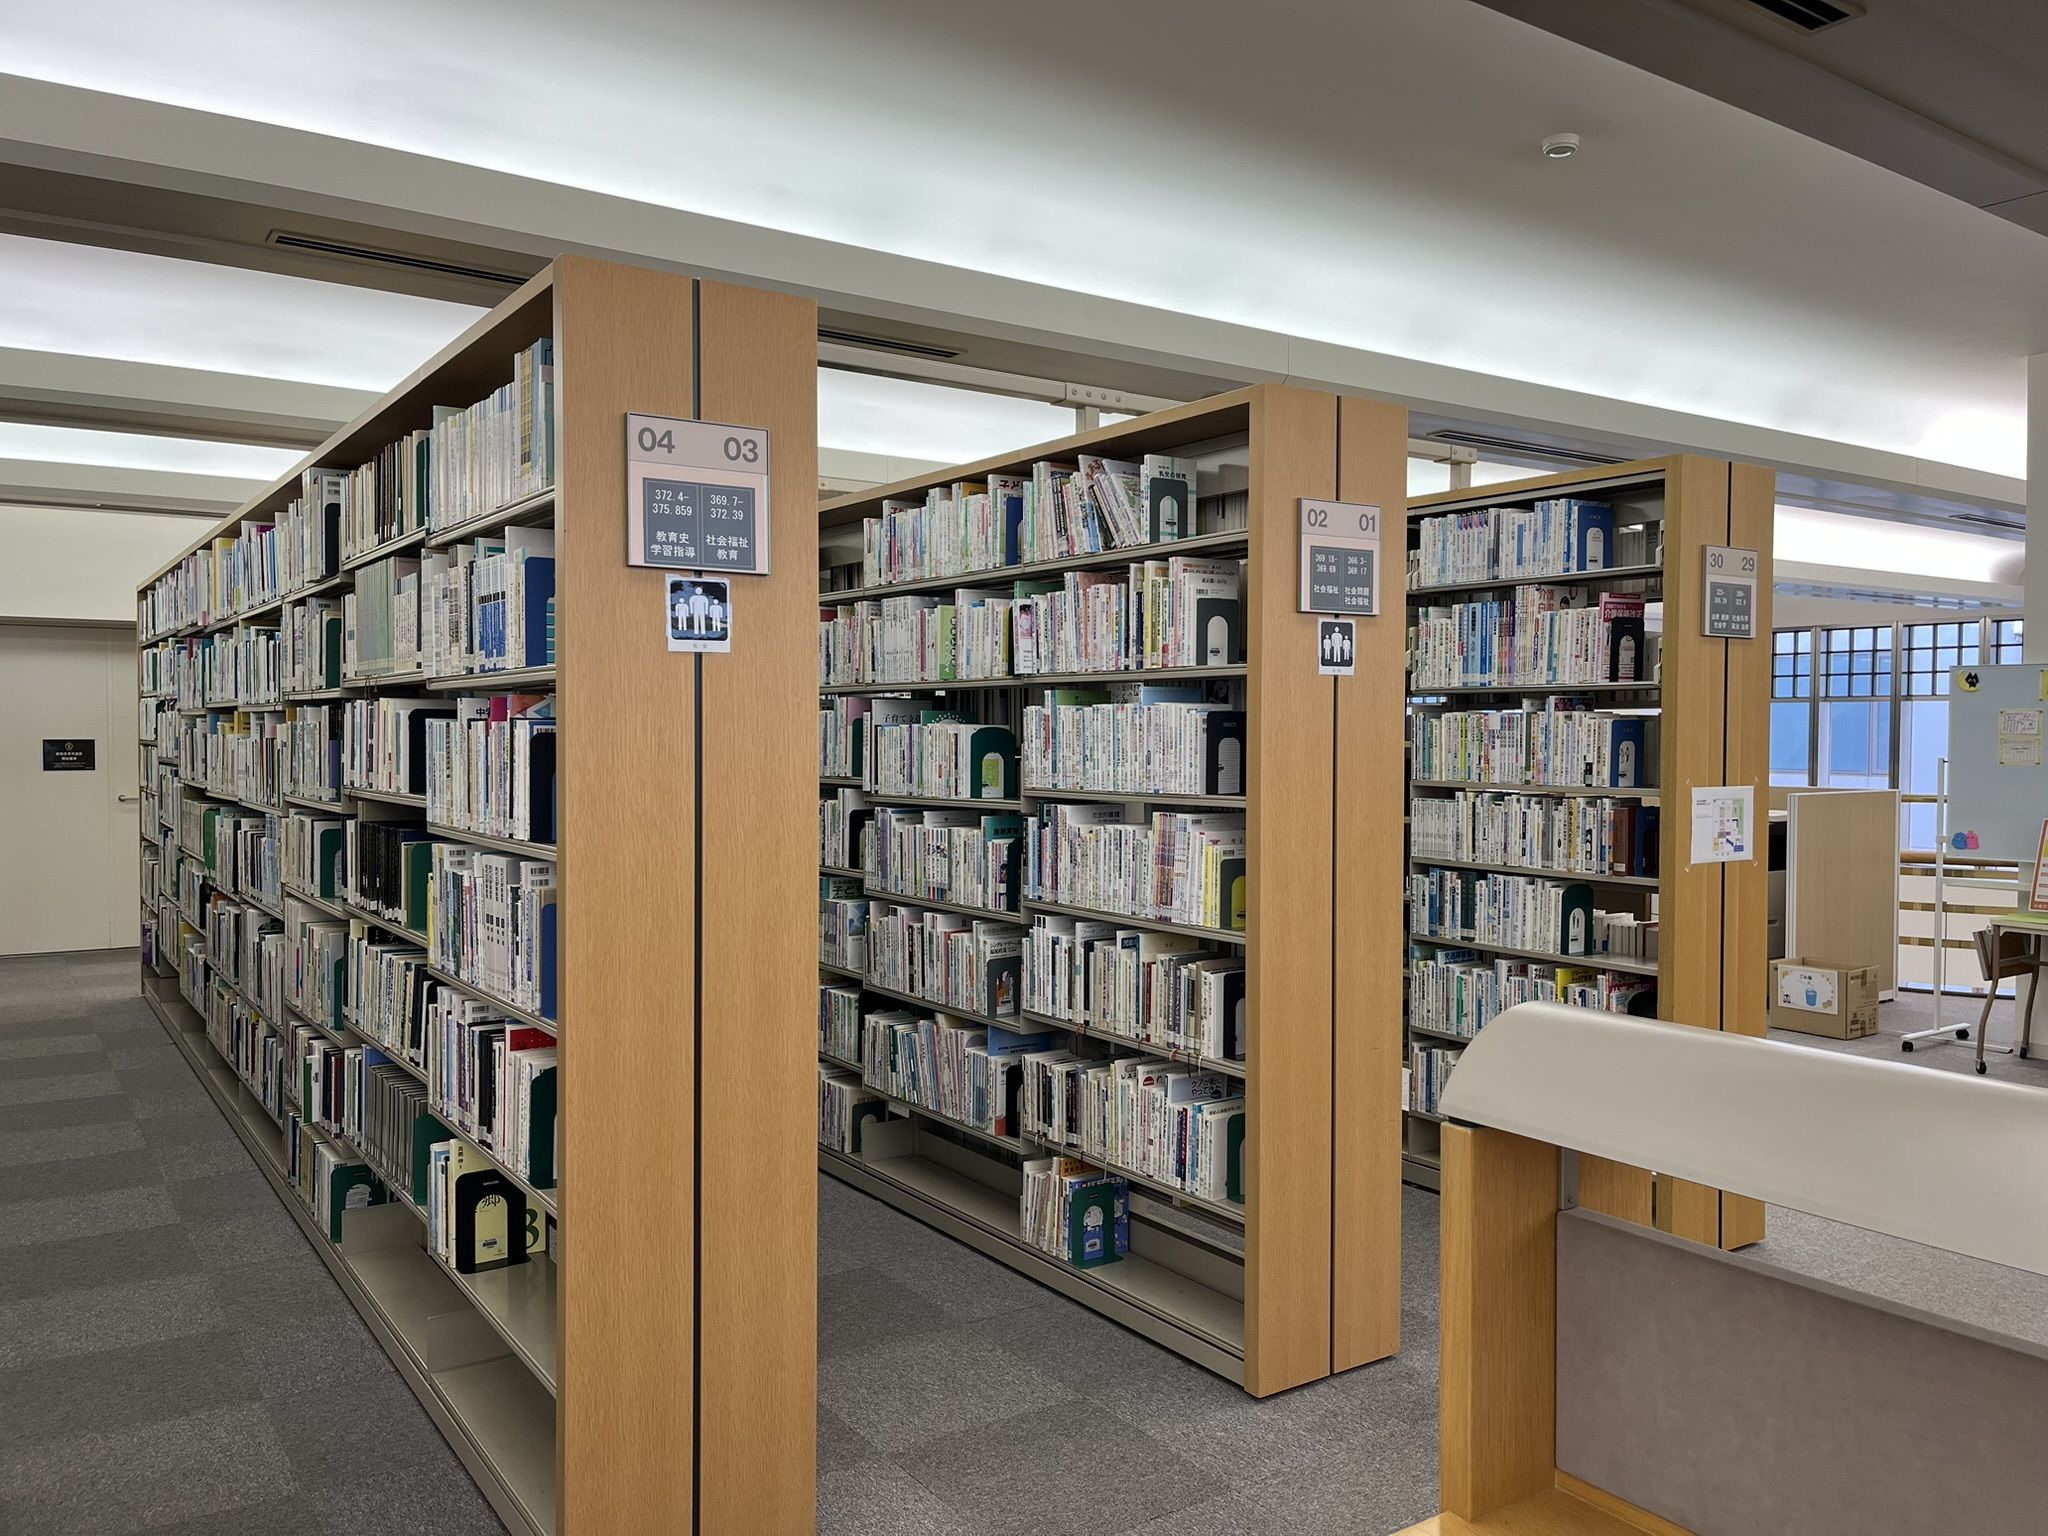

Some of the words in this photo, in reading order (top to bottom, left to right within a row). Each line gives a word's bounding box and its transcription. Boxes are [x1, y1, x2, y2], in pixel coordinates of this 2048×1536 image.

[637, 427, 675, 454] 04
[723, 436, 759, 463] 03
[655, 489, 689, 502] 372.4-
[710, 494, 743, 507] 369.7-
[652, 503, 692, 516] 375.859
[710, 507, 744, 521] 372.39
[1307, 508, 1328, 528] 02
[1359, 514, 1376, 533] 01
[655, 530, 690, 544] 教育史
[705, 534, 749, 549] 社会福祉
[650, 544, 696, 559] 学習指導
[716, 548, 738, 561] 教育
[1710, 552, 1724, 569] 30
[1741, 556, 1755, 572] 29
[1313, 584, 1339, 594] 社会福祉
[1344, 586, 1370, 596] 社会問題
[1344, 596, 1370, 606] 社会福祉
